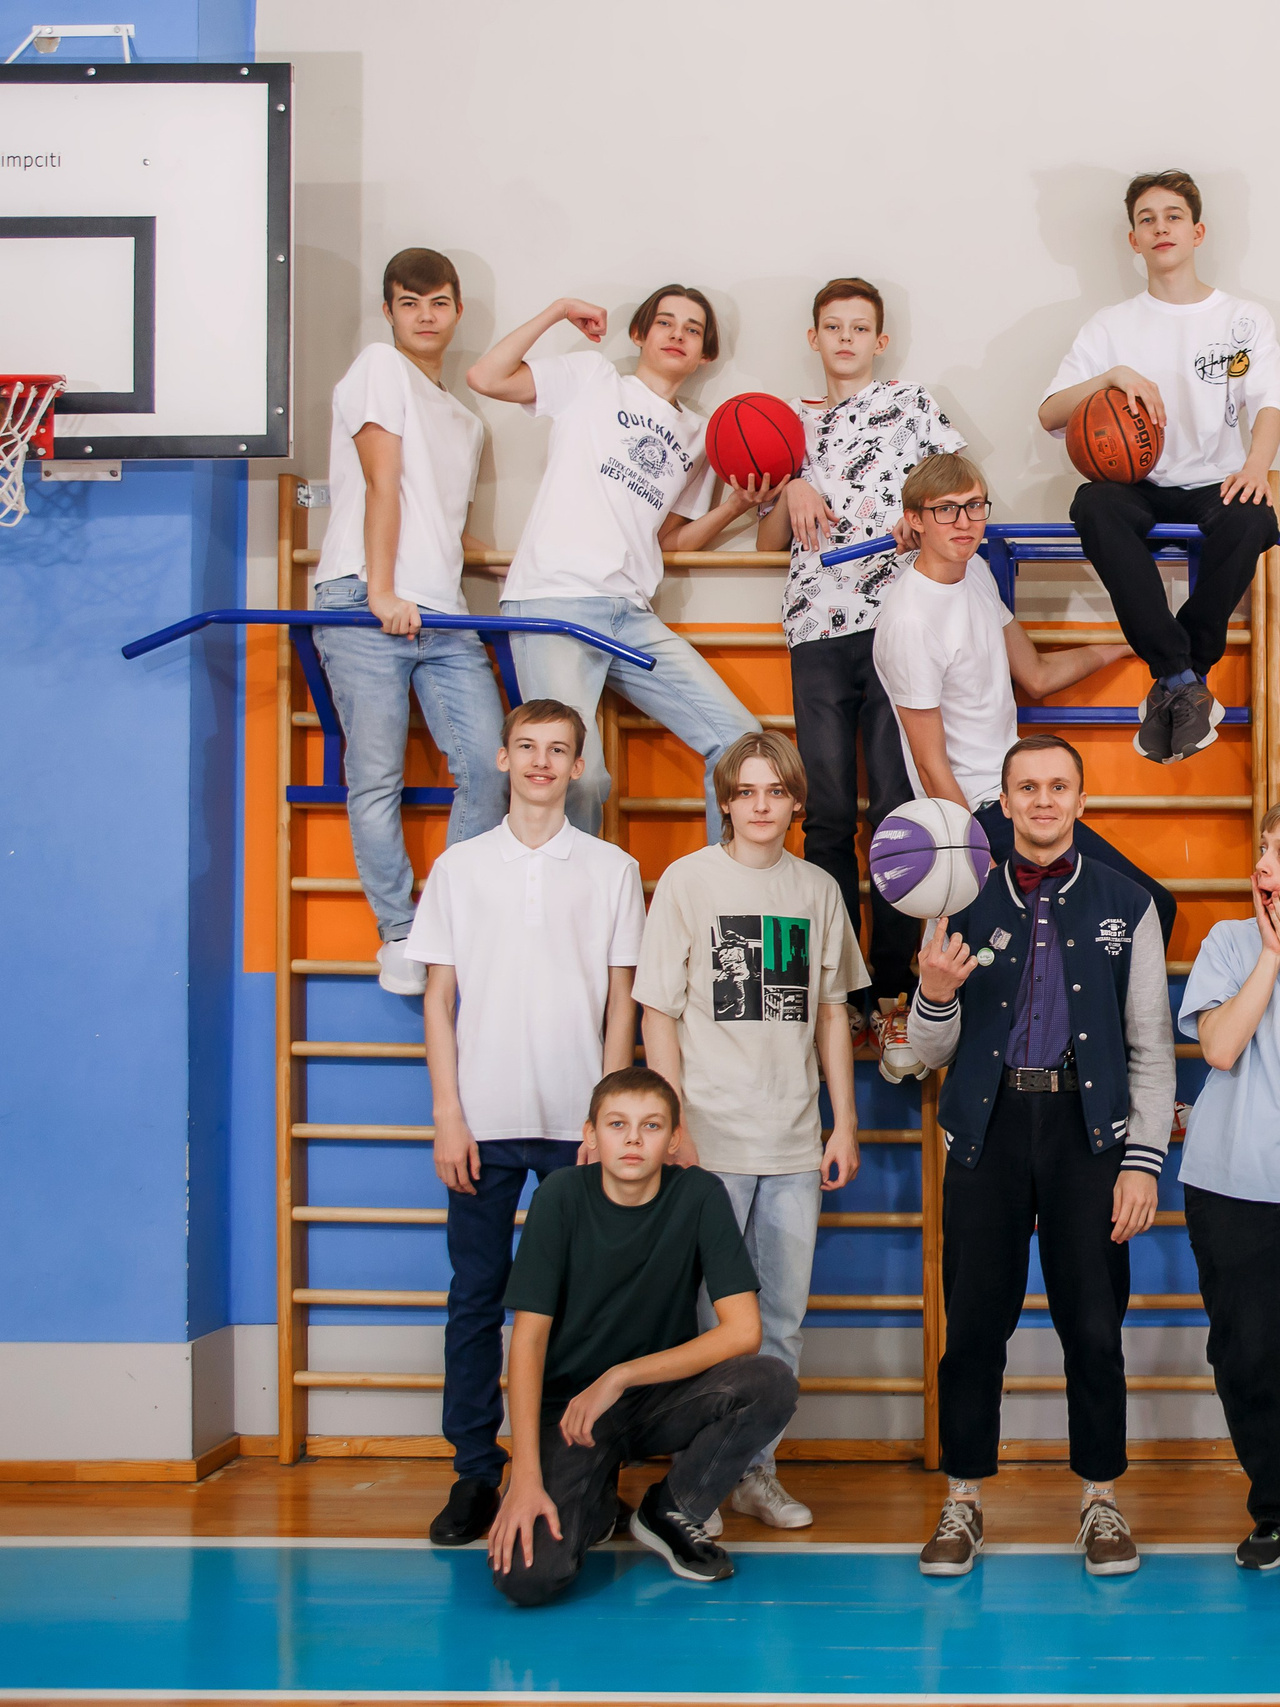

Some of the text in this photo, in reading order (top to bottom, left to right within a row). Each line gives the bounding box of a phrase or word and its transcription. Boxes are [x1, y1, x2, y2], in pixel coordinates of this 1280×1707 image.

[617, 410, 694, 472] QUICKNESS
[600, 463, 663, 510] WEST HIGHWAY
[624, 468, 637, 479] CAR
